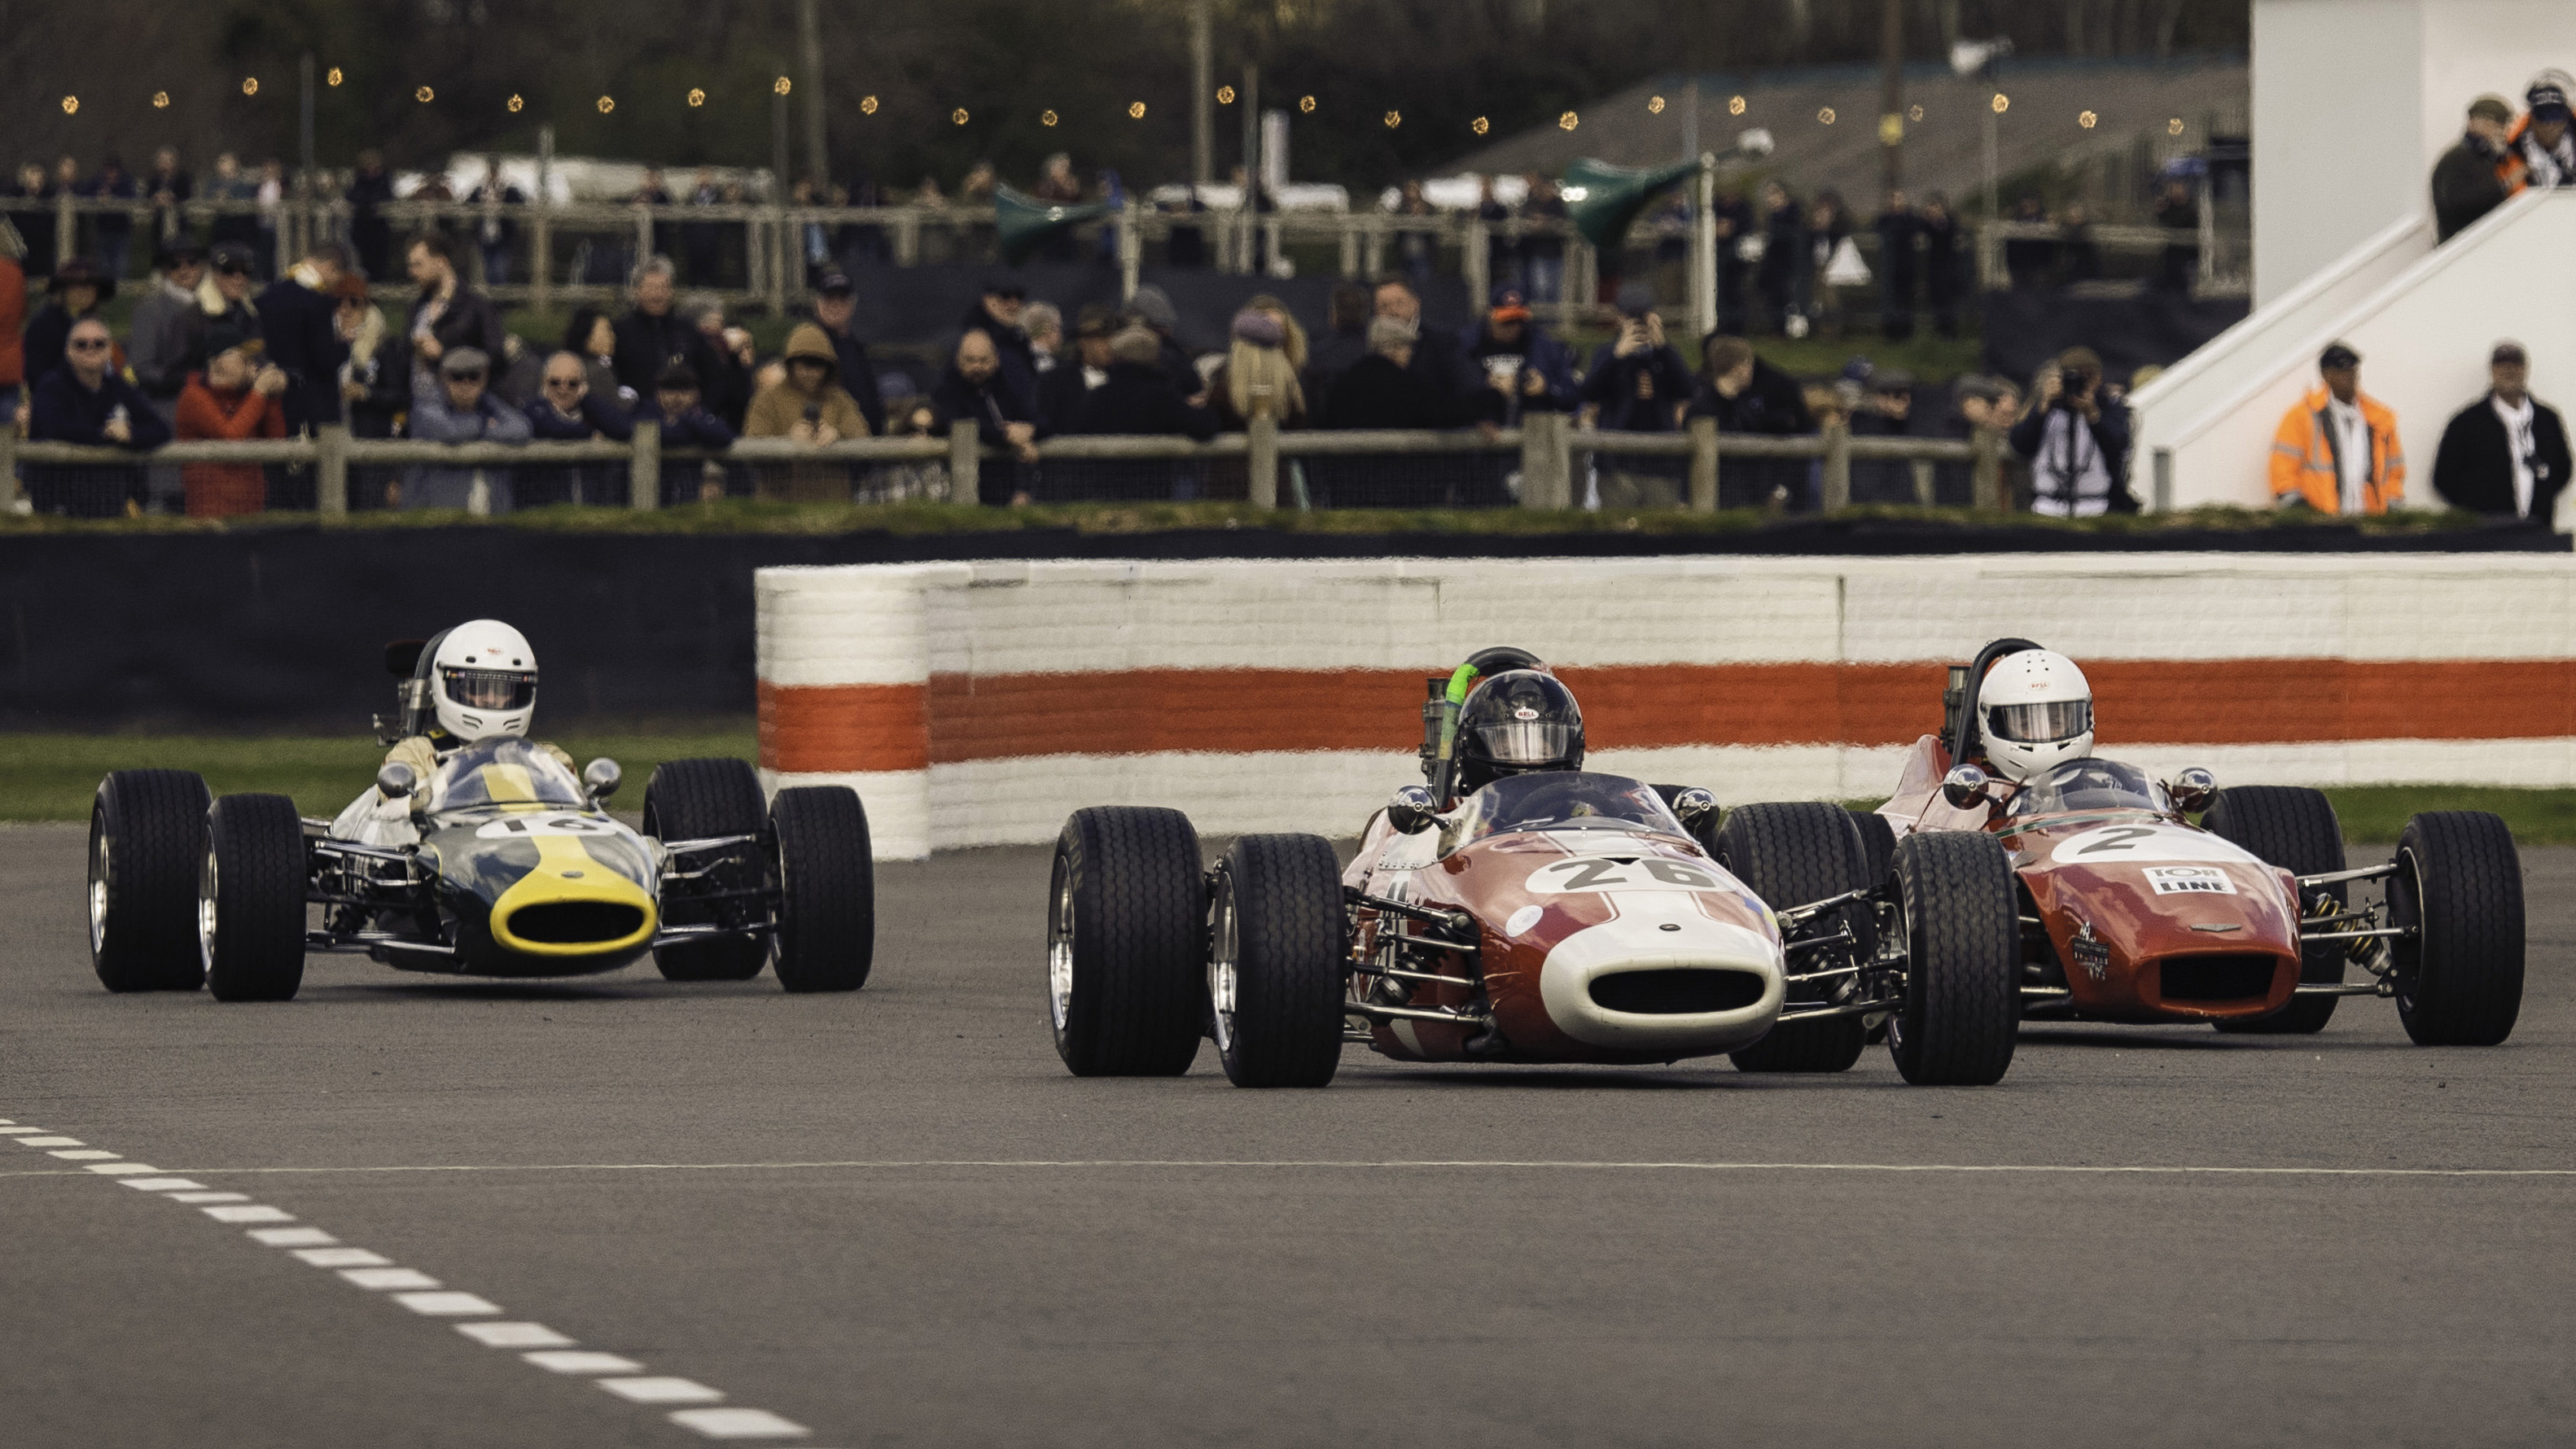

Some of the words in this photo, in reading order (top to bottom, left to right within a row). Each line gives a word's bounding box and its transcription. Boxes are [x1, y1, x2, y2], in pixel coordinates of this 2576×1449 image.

[2077, 827, 2158, 855] 2
[1549, 859, 1716, 891] 26
[2160, 881, 2228, 892] LINE
